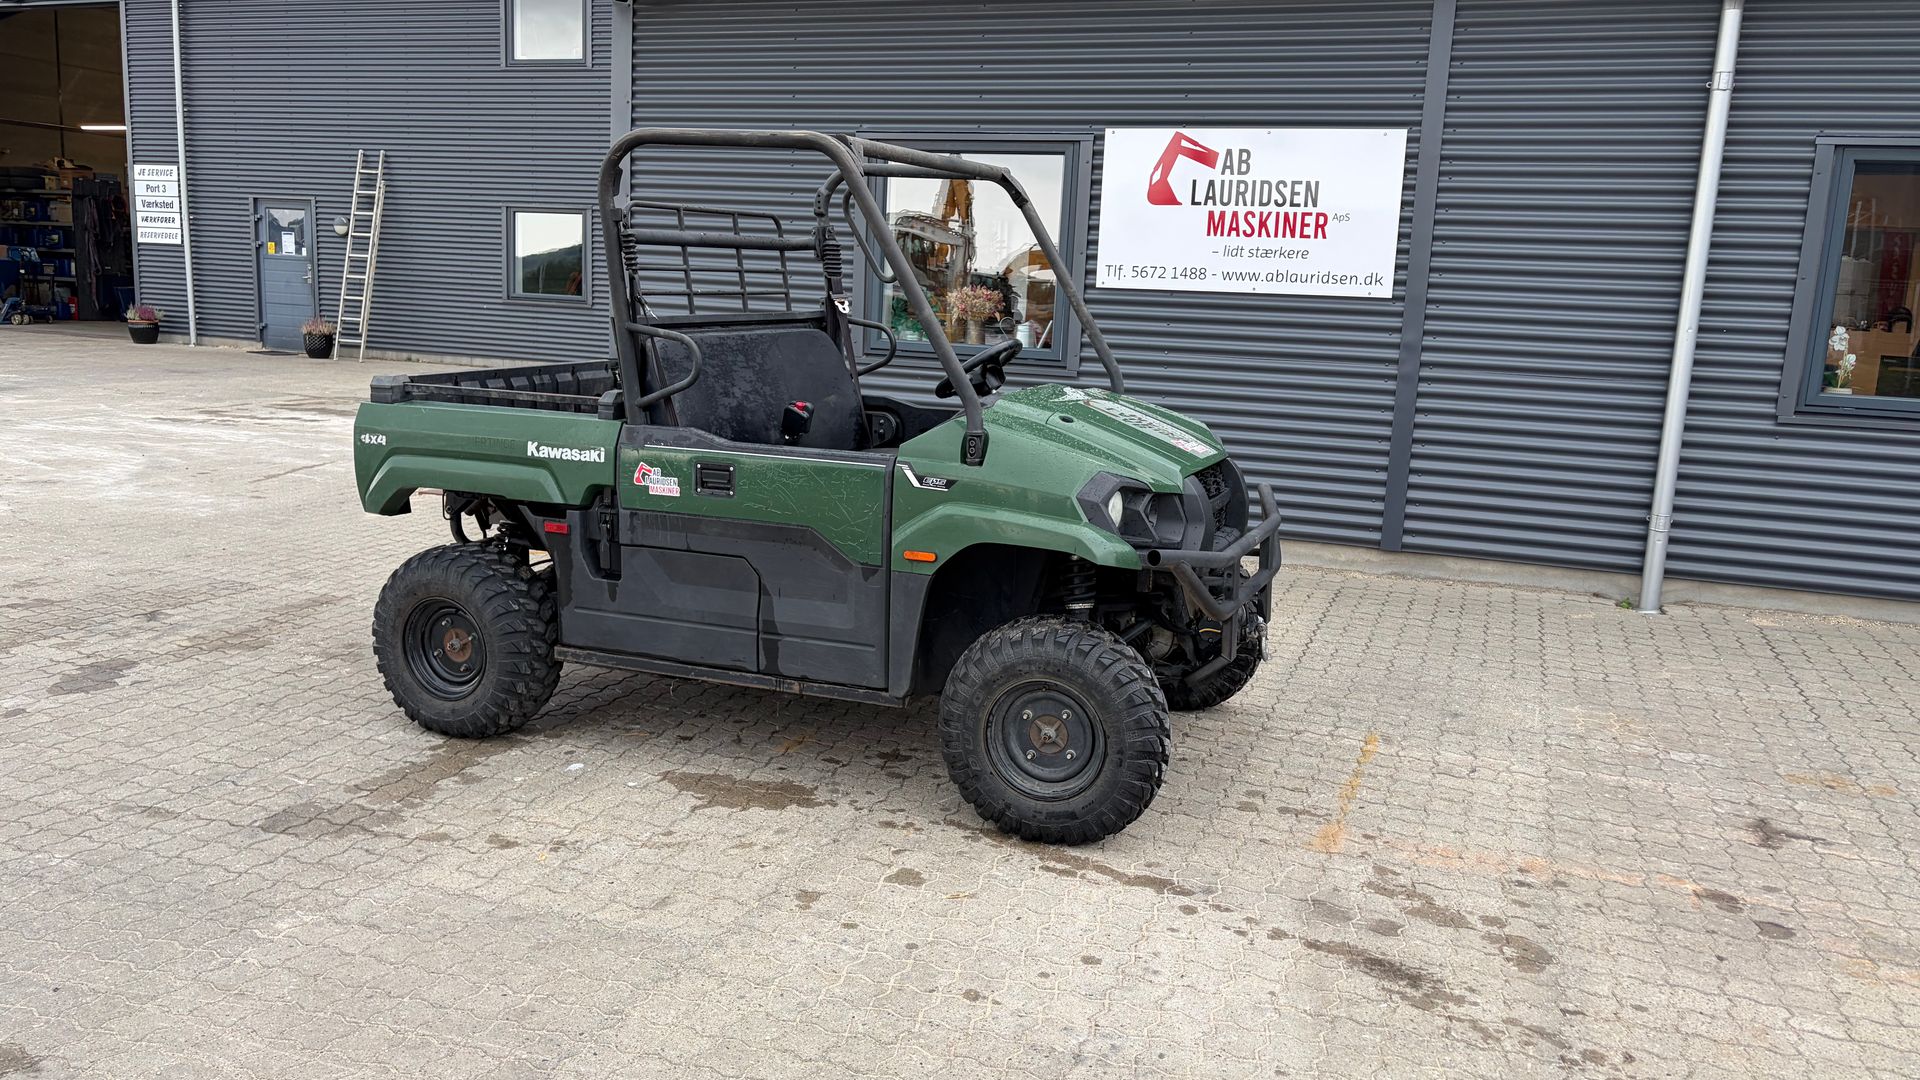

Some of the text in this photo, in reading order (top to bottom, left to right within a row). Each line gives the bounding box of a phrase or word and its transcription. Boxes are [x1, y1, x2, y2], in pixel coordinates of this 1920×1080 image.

[1221, 149, 1252, 175] AB
[147, 168, 173, 177] SERVICE
[146, 184, 167, 193] Port 3
[1191, 179, 1320, 208] LAURIDSEN
[141, 199, 174, 209] Værksted
[1206, 210, 1351, 239] MASKINER ApS
[140, 231, 178, 240] RESERVEDELE
[1223, 245, 1245, 258] lidt
[1247, 245, 1310, 260] stærkere
[1105, 264, 1127, 281] Tlf.
[1131, 265, 1167, 279] 5672
[1170, 266, 1208, 280] 1488
[1221, 269, 1384, 287] www.ablauridsen.dk
[360, 433, 386, 446] 4x4
[527, 441, 605, 463] Kawasaki
[646, 476, 678, 486] LAURIDSEN
[650, 485, 680, 494] MASKINER
